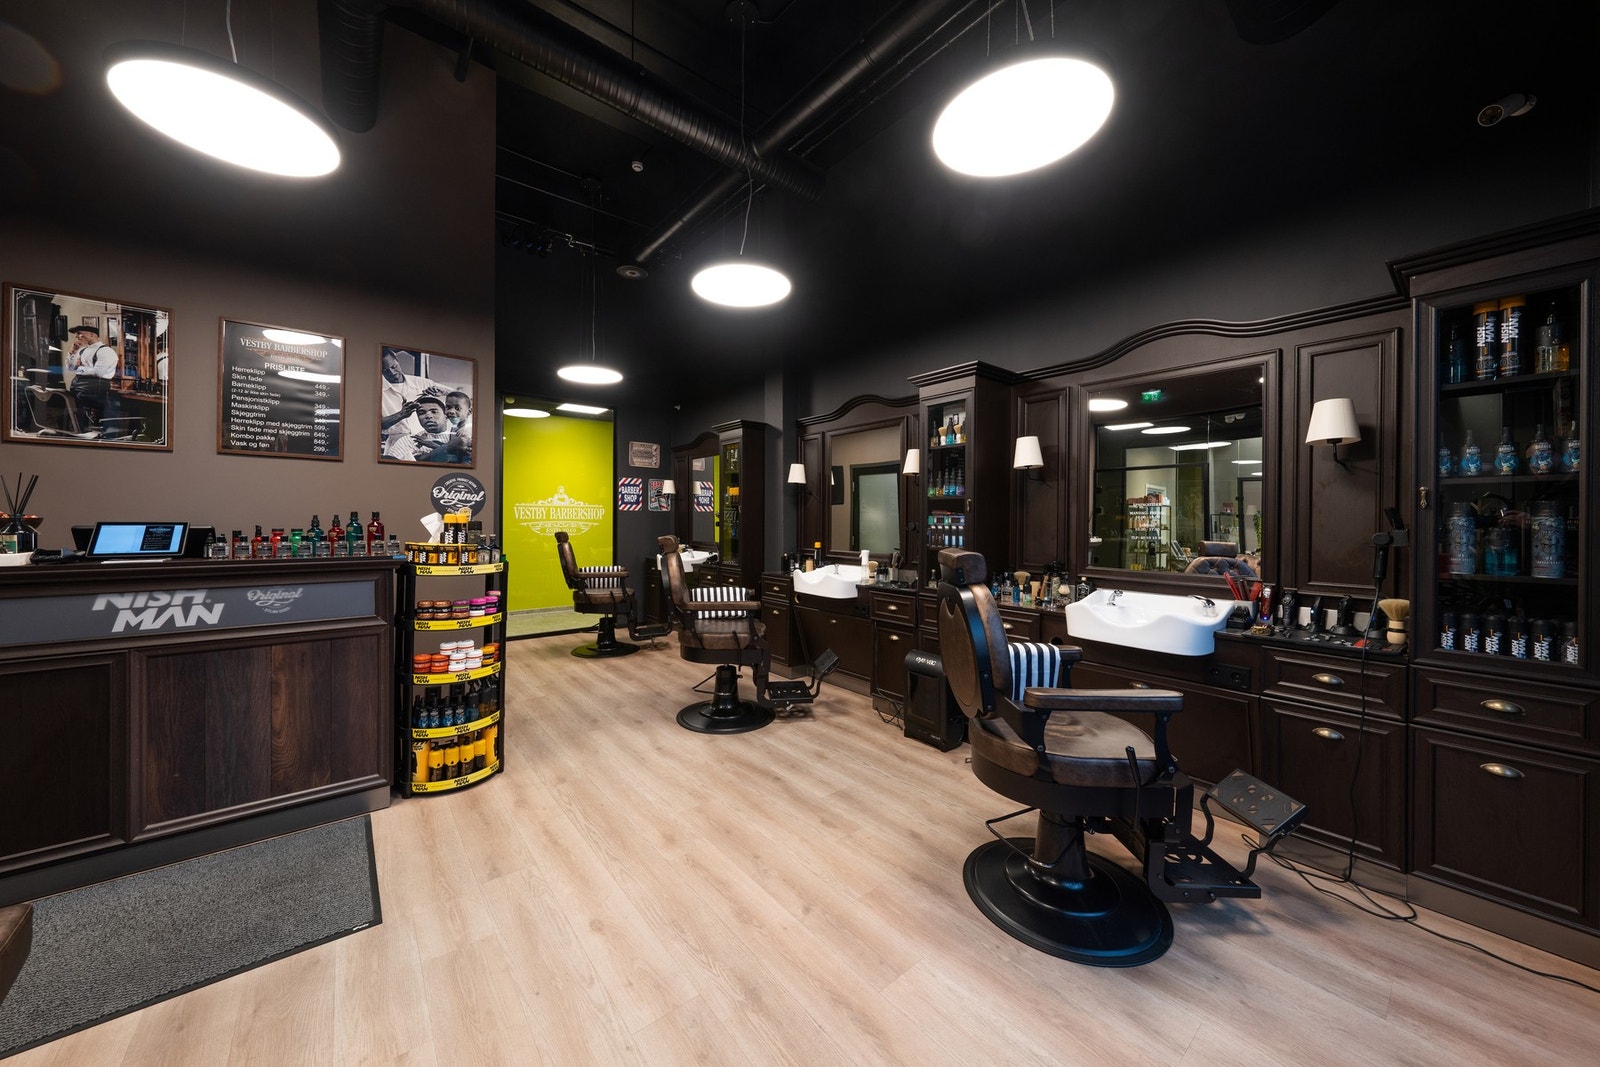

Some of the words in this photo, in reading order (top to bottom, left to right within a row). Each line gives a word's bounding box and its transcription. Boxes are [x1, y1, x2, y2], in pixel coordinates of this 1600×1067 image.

[1486, 322, 1494, 342] MAN
[1509, 318, 1518, 338] MAN
[1477, 327, 1485, 346] NISH
[240, 338, 272, 350] VESTBY
[274, 343, 328, 358] BARBERSHOP
[232, 366, 266, 376] Herreklipp
[264, 362, 306, 373] PRISLISTE
[232, 380, 266, 390] Barneklipp
[232, 394, 280, 406] Pensjonistklipp
[231, 402, 270, 412] Maskinklipp
[231, 409, 266, 418] Skjeggtrim
[230, 417, 265, 426] Herreklipp
[281, 422, 313, 430] skjeggtrim
[278, 429, 310, 437] skjeggtrim
[433, 486, 484, 505] Original
[622, 486, 640, 494] BARBER
[624, 494, 638, 502] SHOP
[514, 506, 547, 520] VESTBY
[550, 506, 605, 520] BARBERSHOP
[247, 588, 303, 606] Original
[112, 603, 224, 632] MAN
